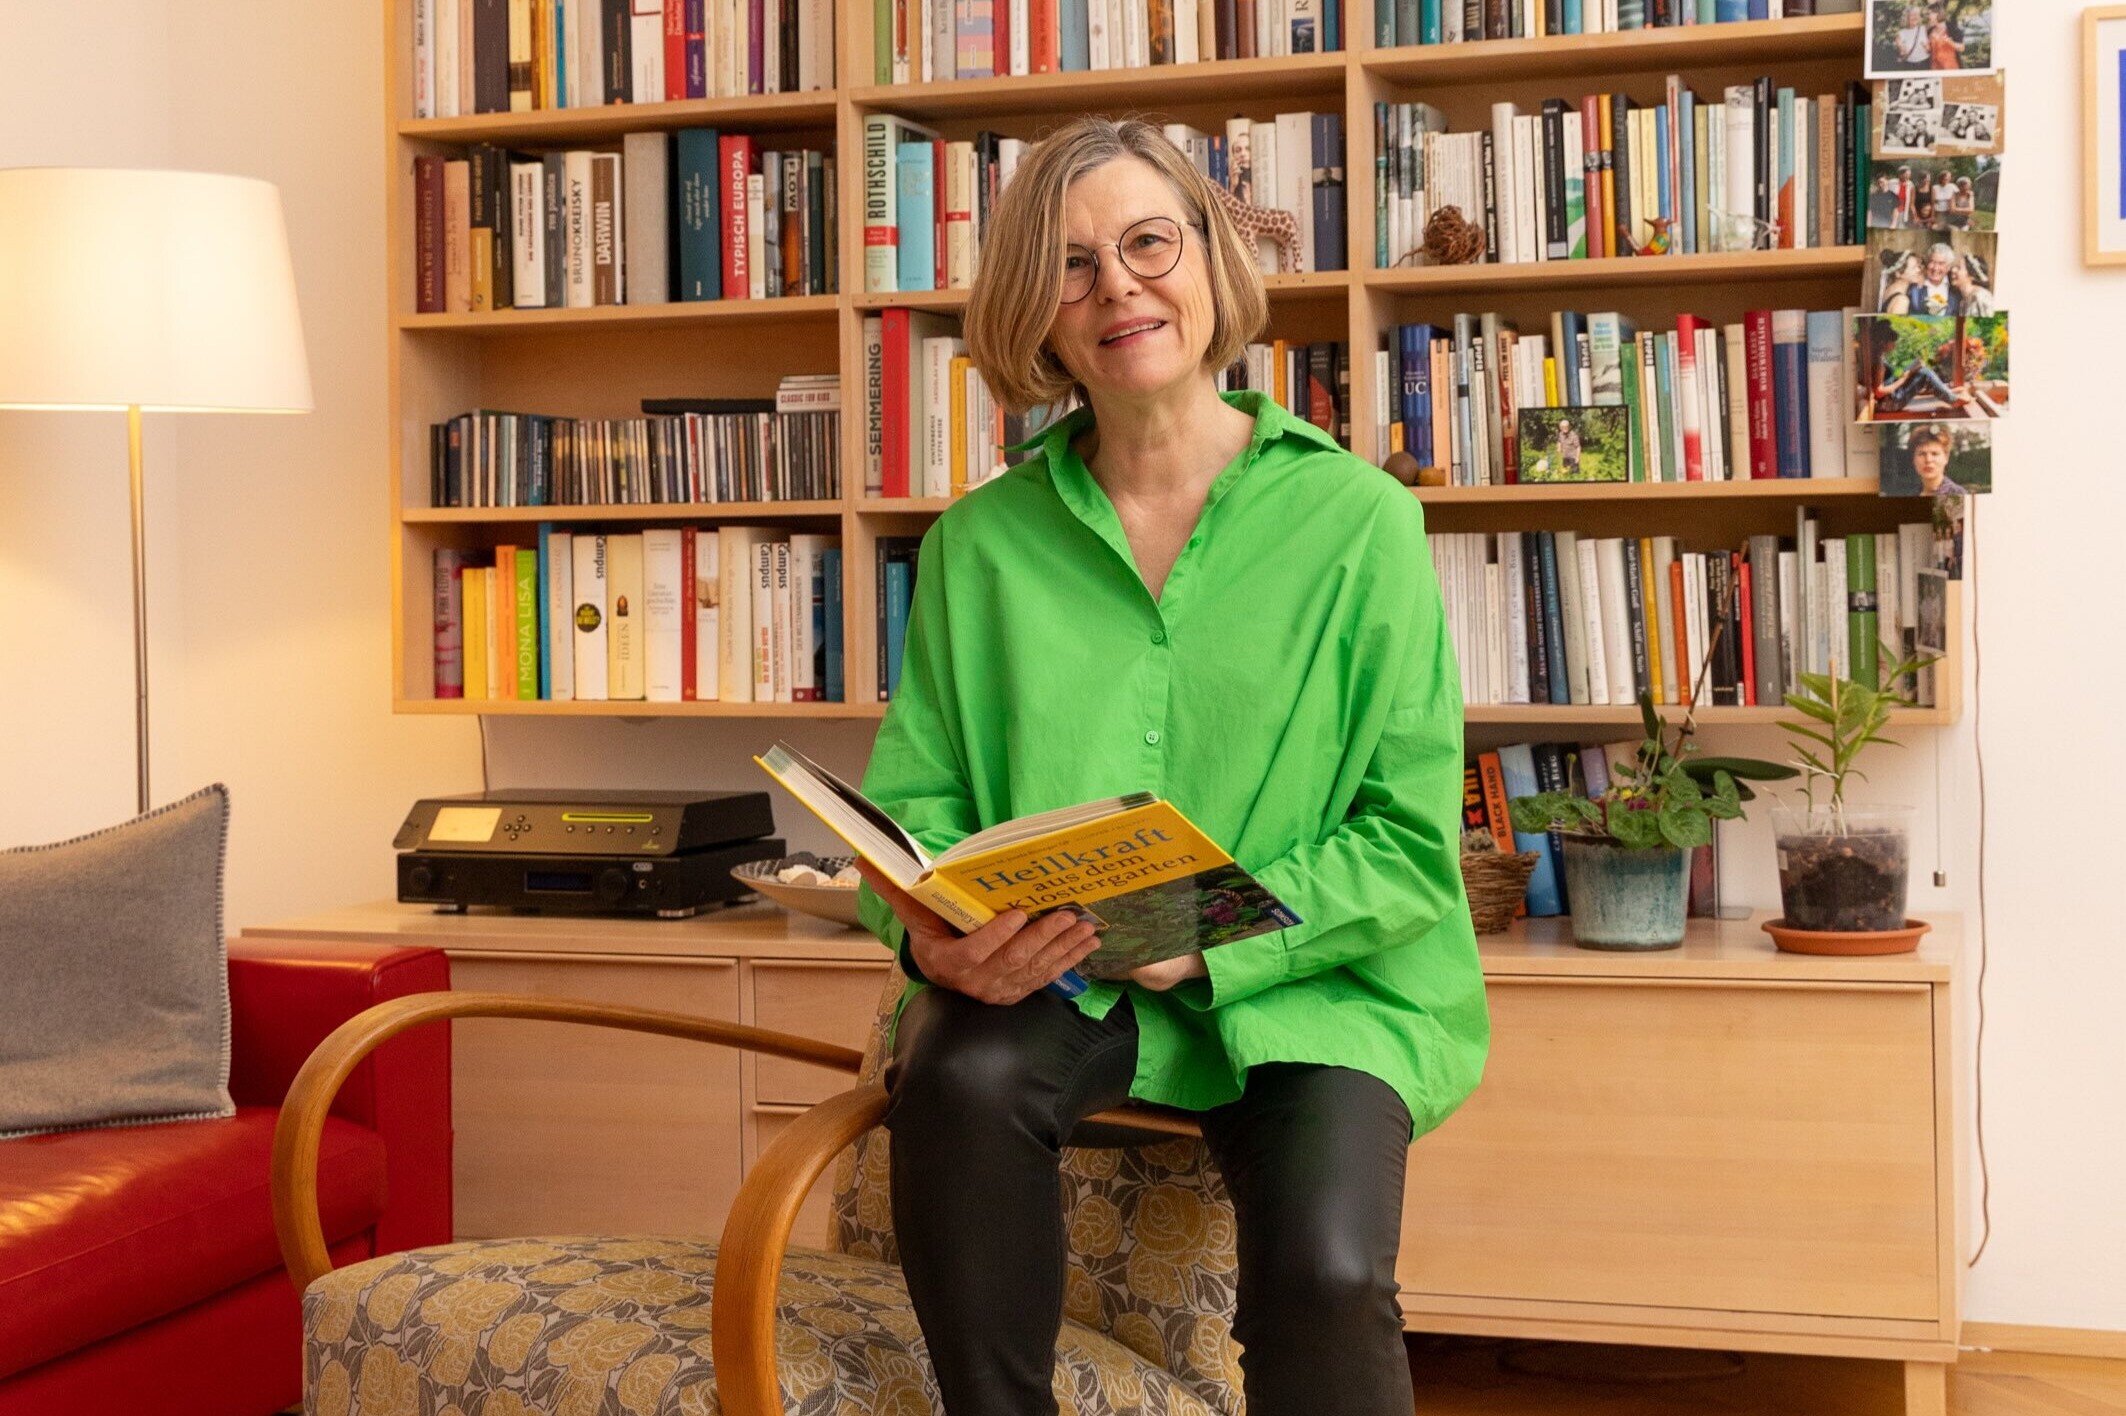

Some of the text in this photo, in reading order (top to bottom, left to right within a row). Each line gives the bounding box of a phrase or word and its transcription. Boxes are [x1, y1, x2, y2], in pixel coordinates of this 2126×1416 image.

[785, 161, 797, 209] FLOW
[867, 123, 886, 219] ROTHSCHILD
[571, 179, 582, 284] BRUNOKREISKY
[595, 201, 611, 265] DARWIN
[732, 150, 745, 277] TYPISCH EUROPA
[1474, 346, 1483, 370] PIPER
[1582, 341, 1591, 367] PIPER
[1645, 339, 1654, 365] PIPER
[869, 343, 881, 456] SEMMERING
[1404, 382, 1427, 395] UC
[594, 535, 606, 579] Campus
[761, 543, 772, 588] Campus
[777, 543, 790, 588] Campus
[519, 576, 532, 681] MONA LISA
[1487, 767, 1506, 838] BLACK HAND
[972, 825, 1176, 894] Heilkraft
[1004, 852, 1198, 912] Klostergarten
[1032, 853, 1146, 893] aus dem
